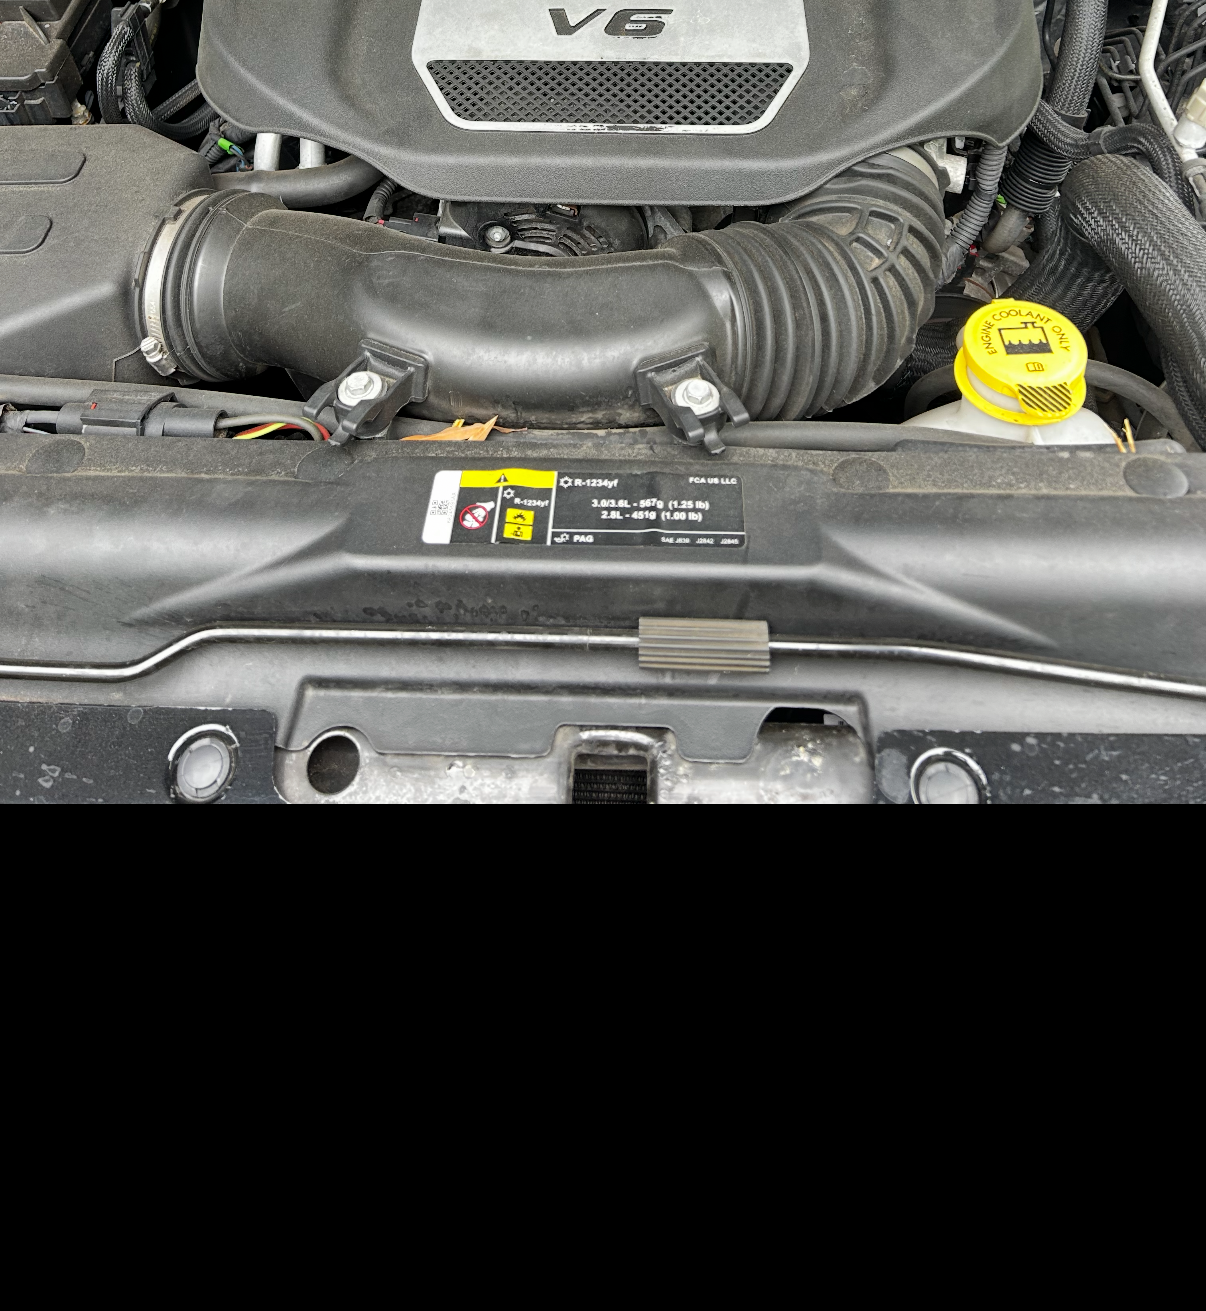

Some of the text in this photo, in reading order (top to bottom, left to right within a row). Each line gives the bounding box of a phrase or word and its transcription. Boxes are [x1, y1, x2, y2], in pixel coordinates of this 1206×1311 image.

[548, 8, 674, 38] V6
[981, 309, 1070, 355] ENGINE COOLANT ONLY
[574, 478, 619, 489] R-1234yf
[707, 477, 719, 485] US
[720, 477, 738, 485] LLC
[514, 497, 549, 508] R-1234yf
[591, 498, 631, 508] 3.0/3.6L
[639, 497, 664, 509] 567g
[668, 499, 694, 510] (1.25
[695, 500, 710, 510] lb)
[600, 510, 624, 520] 2.8L
[631, 510, 657, 520] 451g
[661, 511, 686, 521] (1.00
[688, 511, 703, 522] lb)
[573, 535, 594, 543] PAG
[660, 536, 675, 544] SAE
